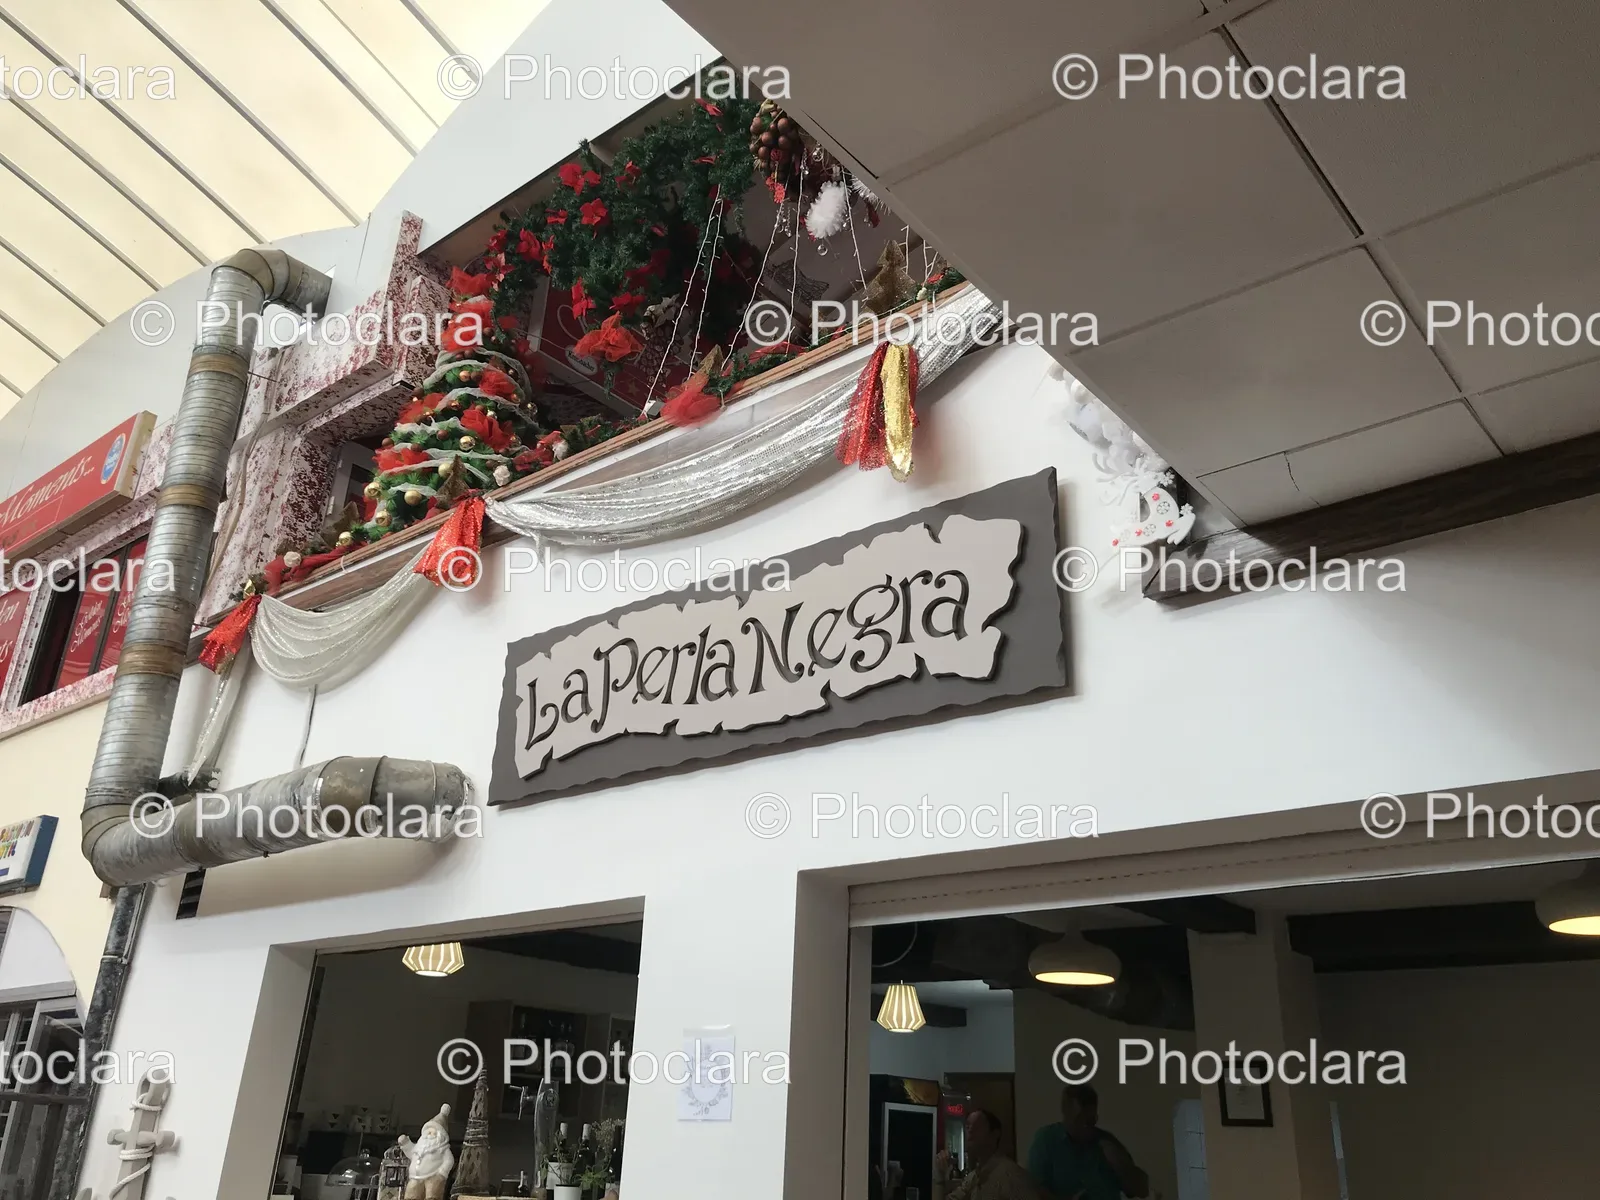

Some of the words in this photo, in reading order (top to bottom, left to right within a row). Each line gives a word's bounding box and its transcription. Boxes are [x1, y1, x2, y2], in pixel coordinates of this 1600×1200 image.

[524, 669, 591, 750] La
[590, 626, 735, 733] Perla
[744, 568, 972, 695] Negra
